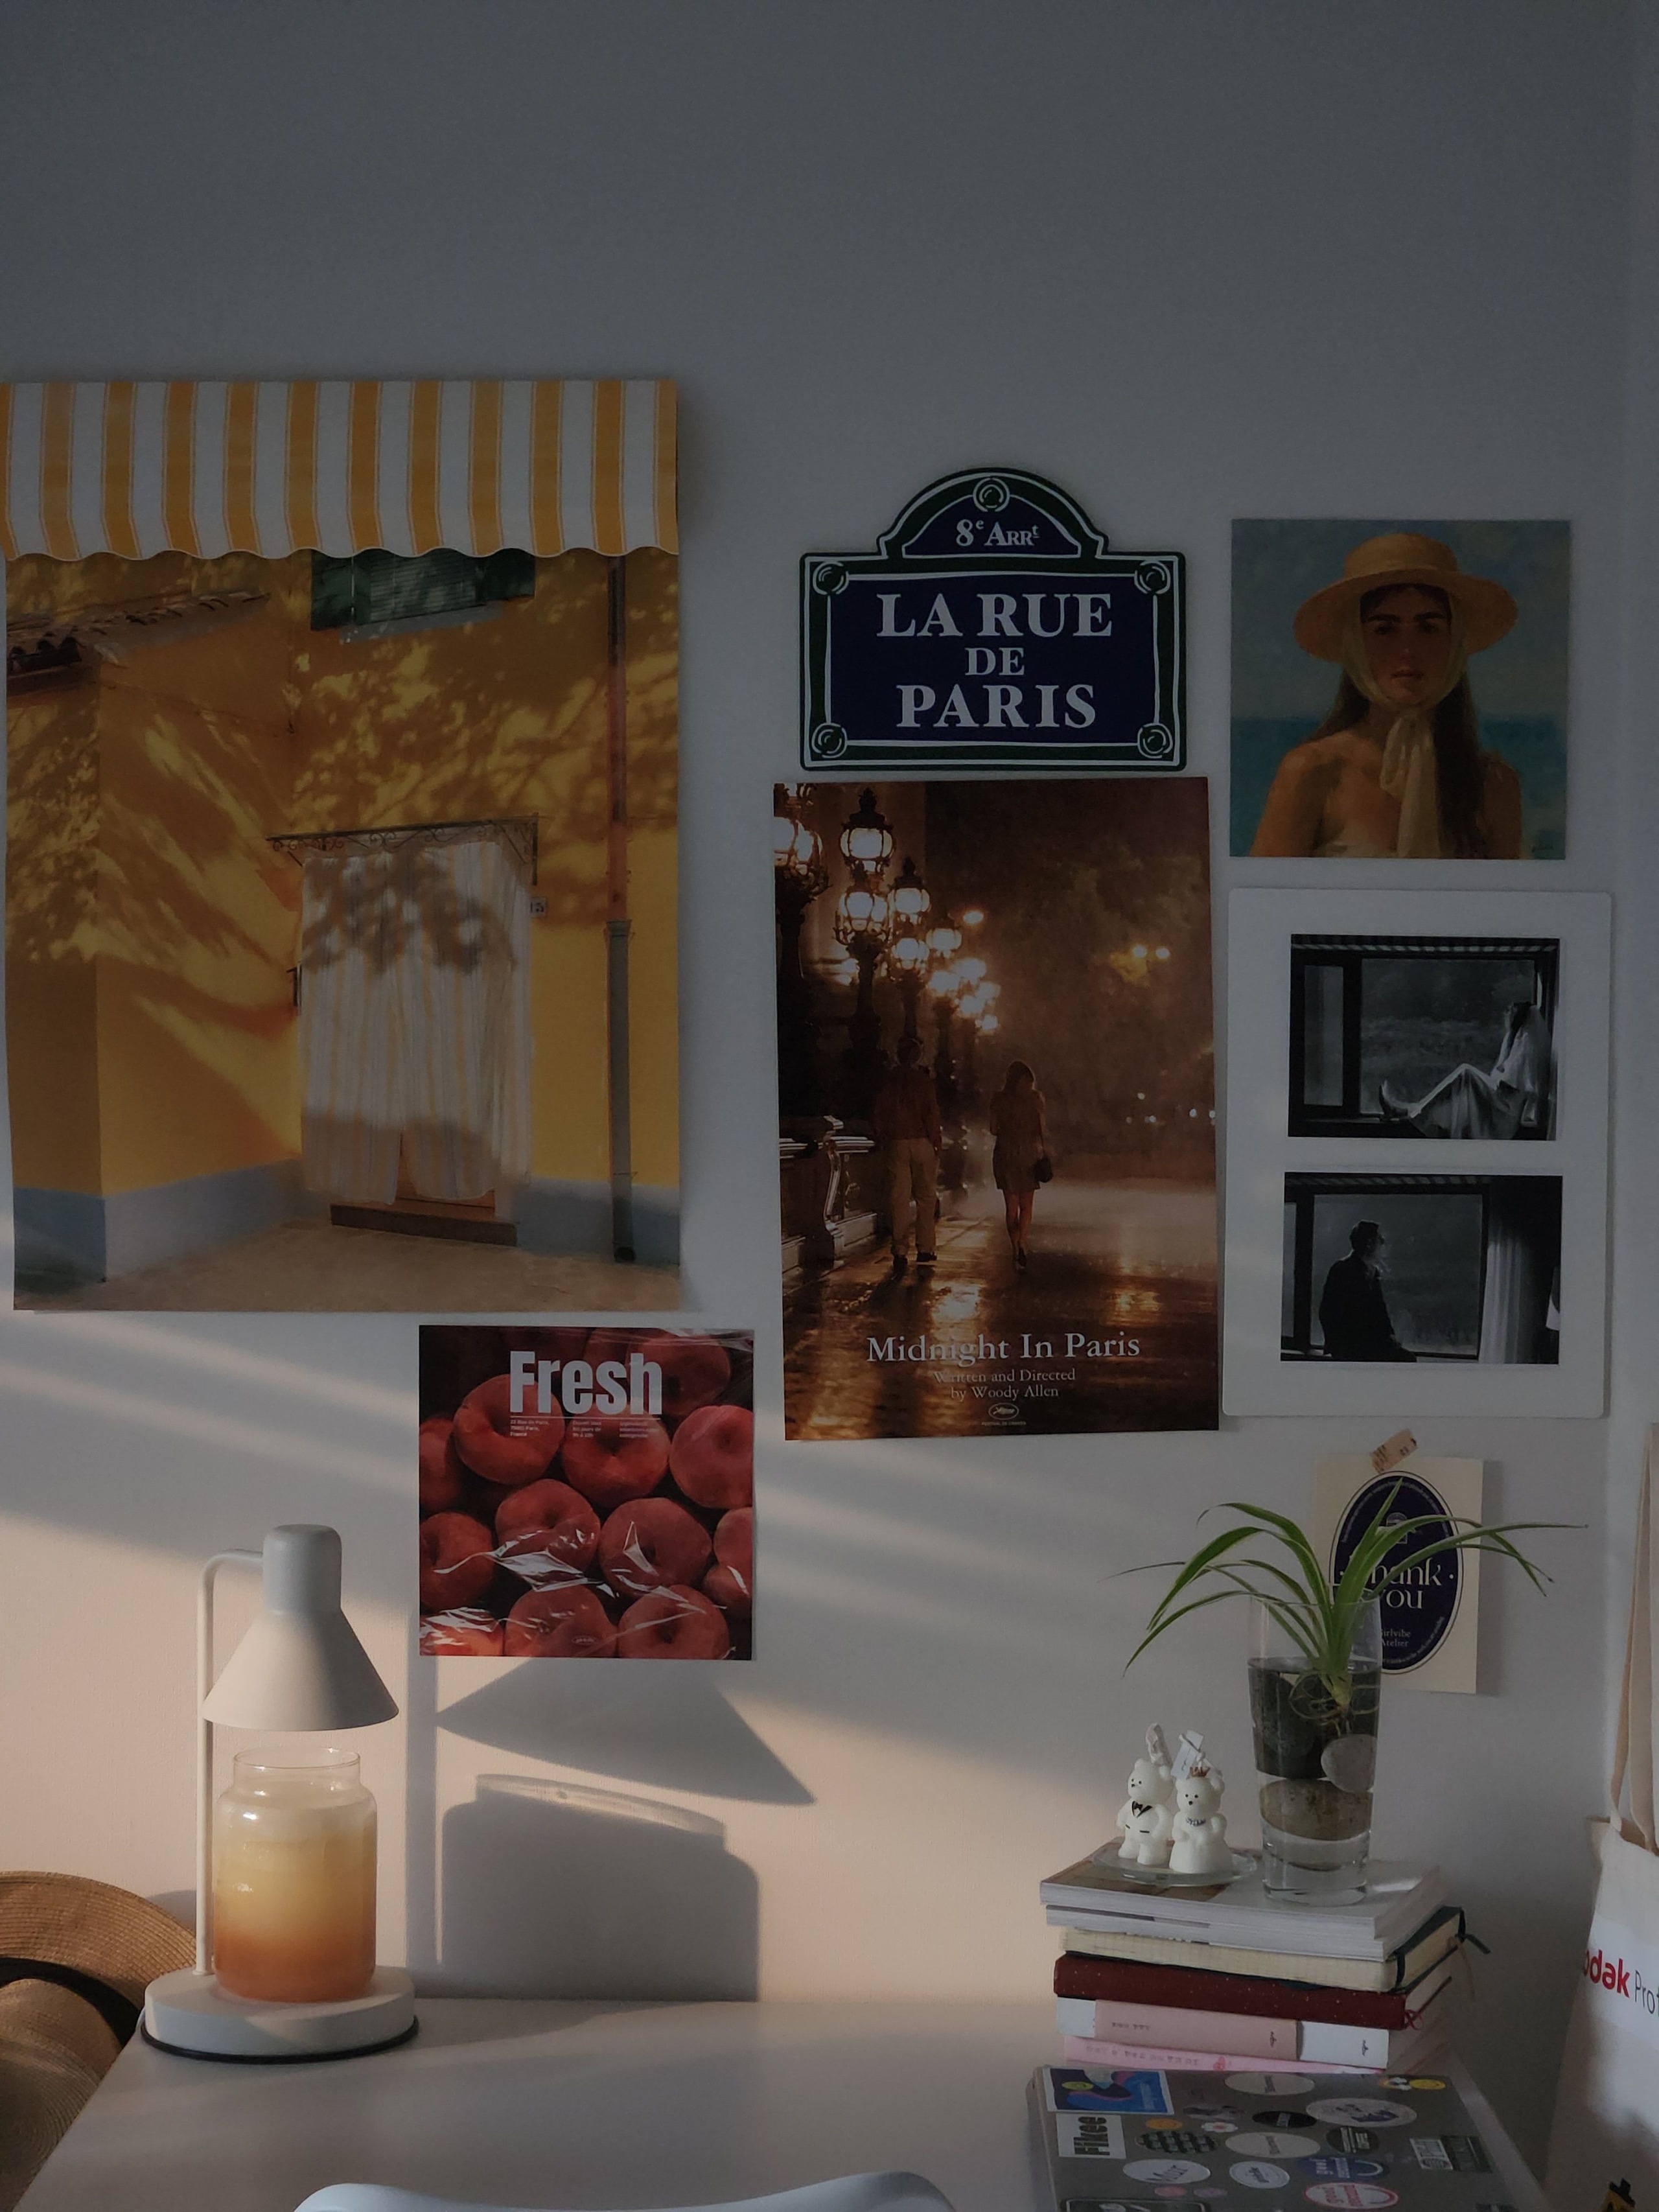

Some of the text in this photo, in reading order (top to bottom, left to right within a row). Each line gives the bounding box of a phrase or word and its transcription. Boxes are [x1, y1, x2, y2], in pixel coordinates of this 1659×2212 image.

[876, 592, 1113, 638] LA RUE
[964, 646, 1025, 676] DE
[896, 683, 1096, 729] PARIS
[866, 1331, 1141, 1366] Midnight In Paris
[509, 1350, 662, 1415] Fresh
[933, 1368, 1076, 1383] Written and Directed
[951, 1384, 1060, 1401] by Woody Allen
[1352, 1557, 1442, 1586] hank
[1380, 1589, 1423, 1609] ou
[1381, 1629, 1411, 1638] irlvibe
[1635, 1970, 1659, 2015] Pro
